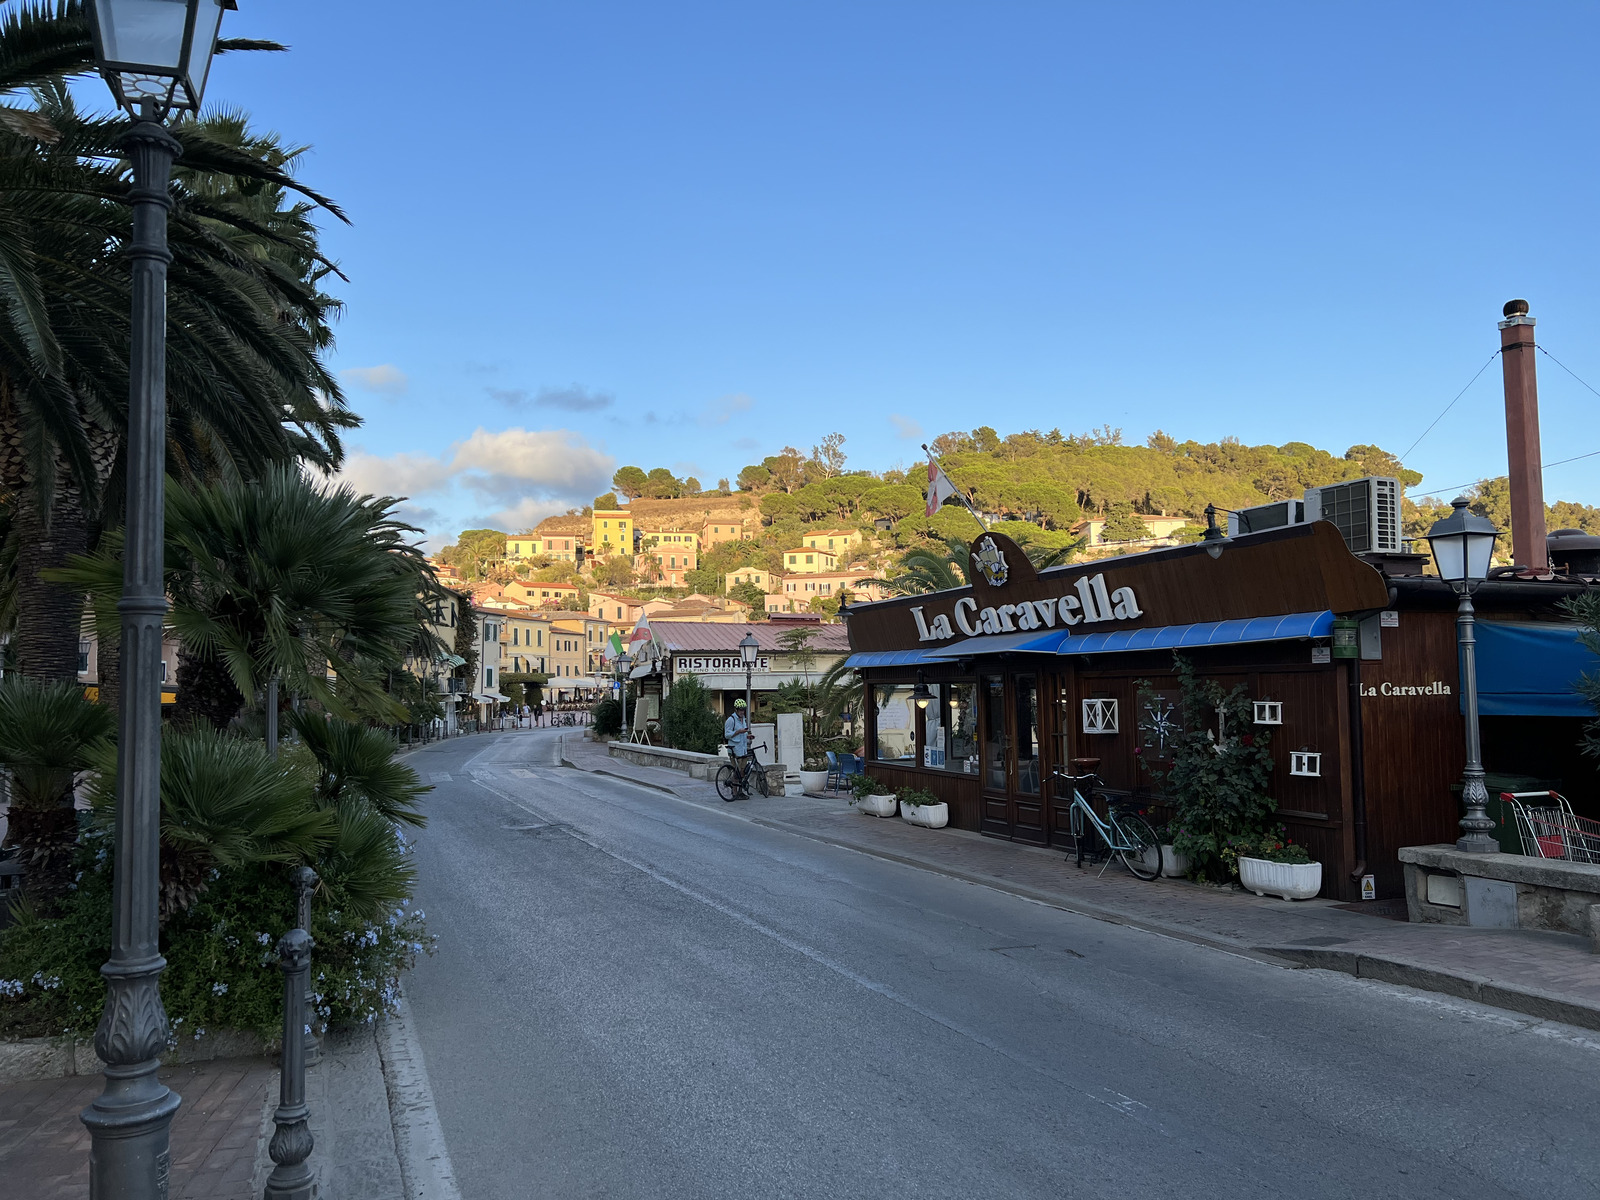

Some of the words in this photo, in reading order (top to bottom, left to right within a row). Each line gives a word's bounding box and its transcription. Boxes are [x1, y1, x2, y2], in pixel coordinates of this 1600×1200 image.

[910, 605, 955, 641] La
[954, 573, 1143, 636] Caravella
[1360, 682, 1377, 697] La
[1380, 681, 1452, 696] Caravella
